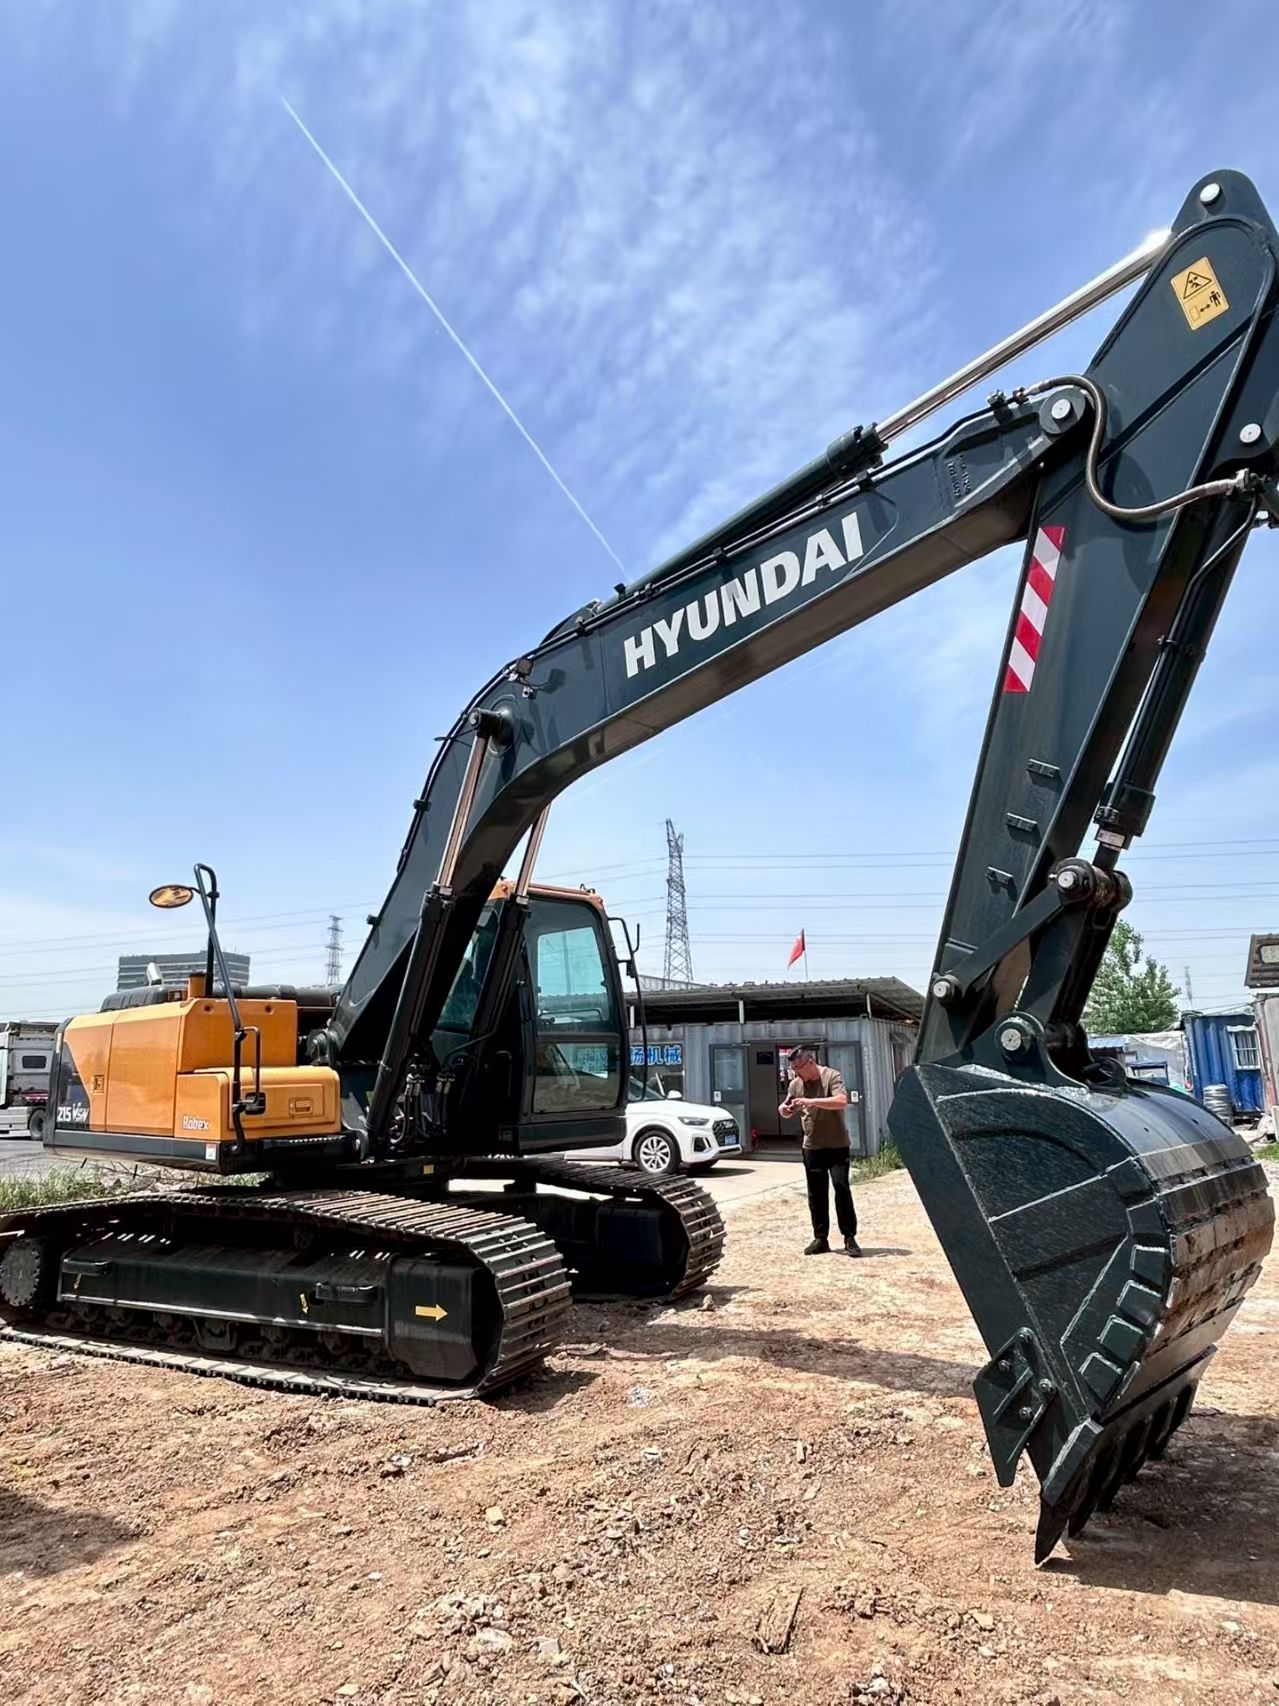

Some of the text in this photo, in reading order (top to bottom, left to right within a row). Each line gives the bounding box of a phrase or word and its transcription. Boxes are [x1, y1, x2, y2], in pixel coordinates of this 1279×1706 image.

[623, 511, 864, 679] HYUNDAI
[57, 1106, 72, 1122] 215
[183, 1115, 209, 1130] Robex
